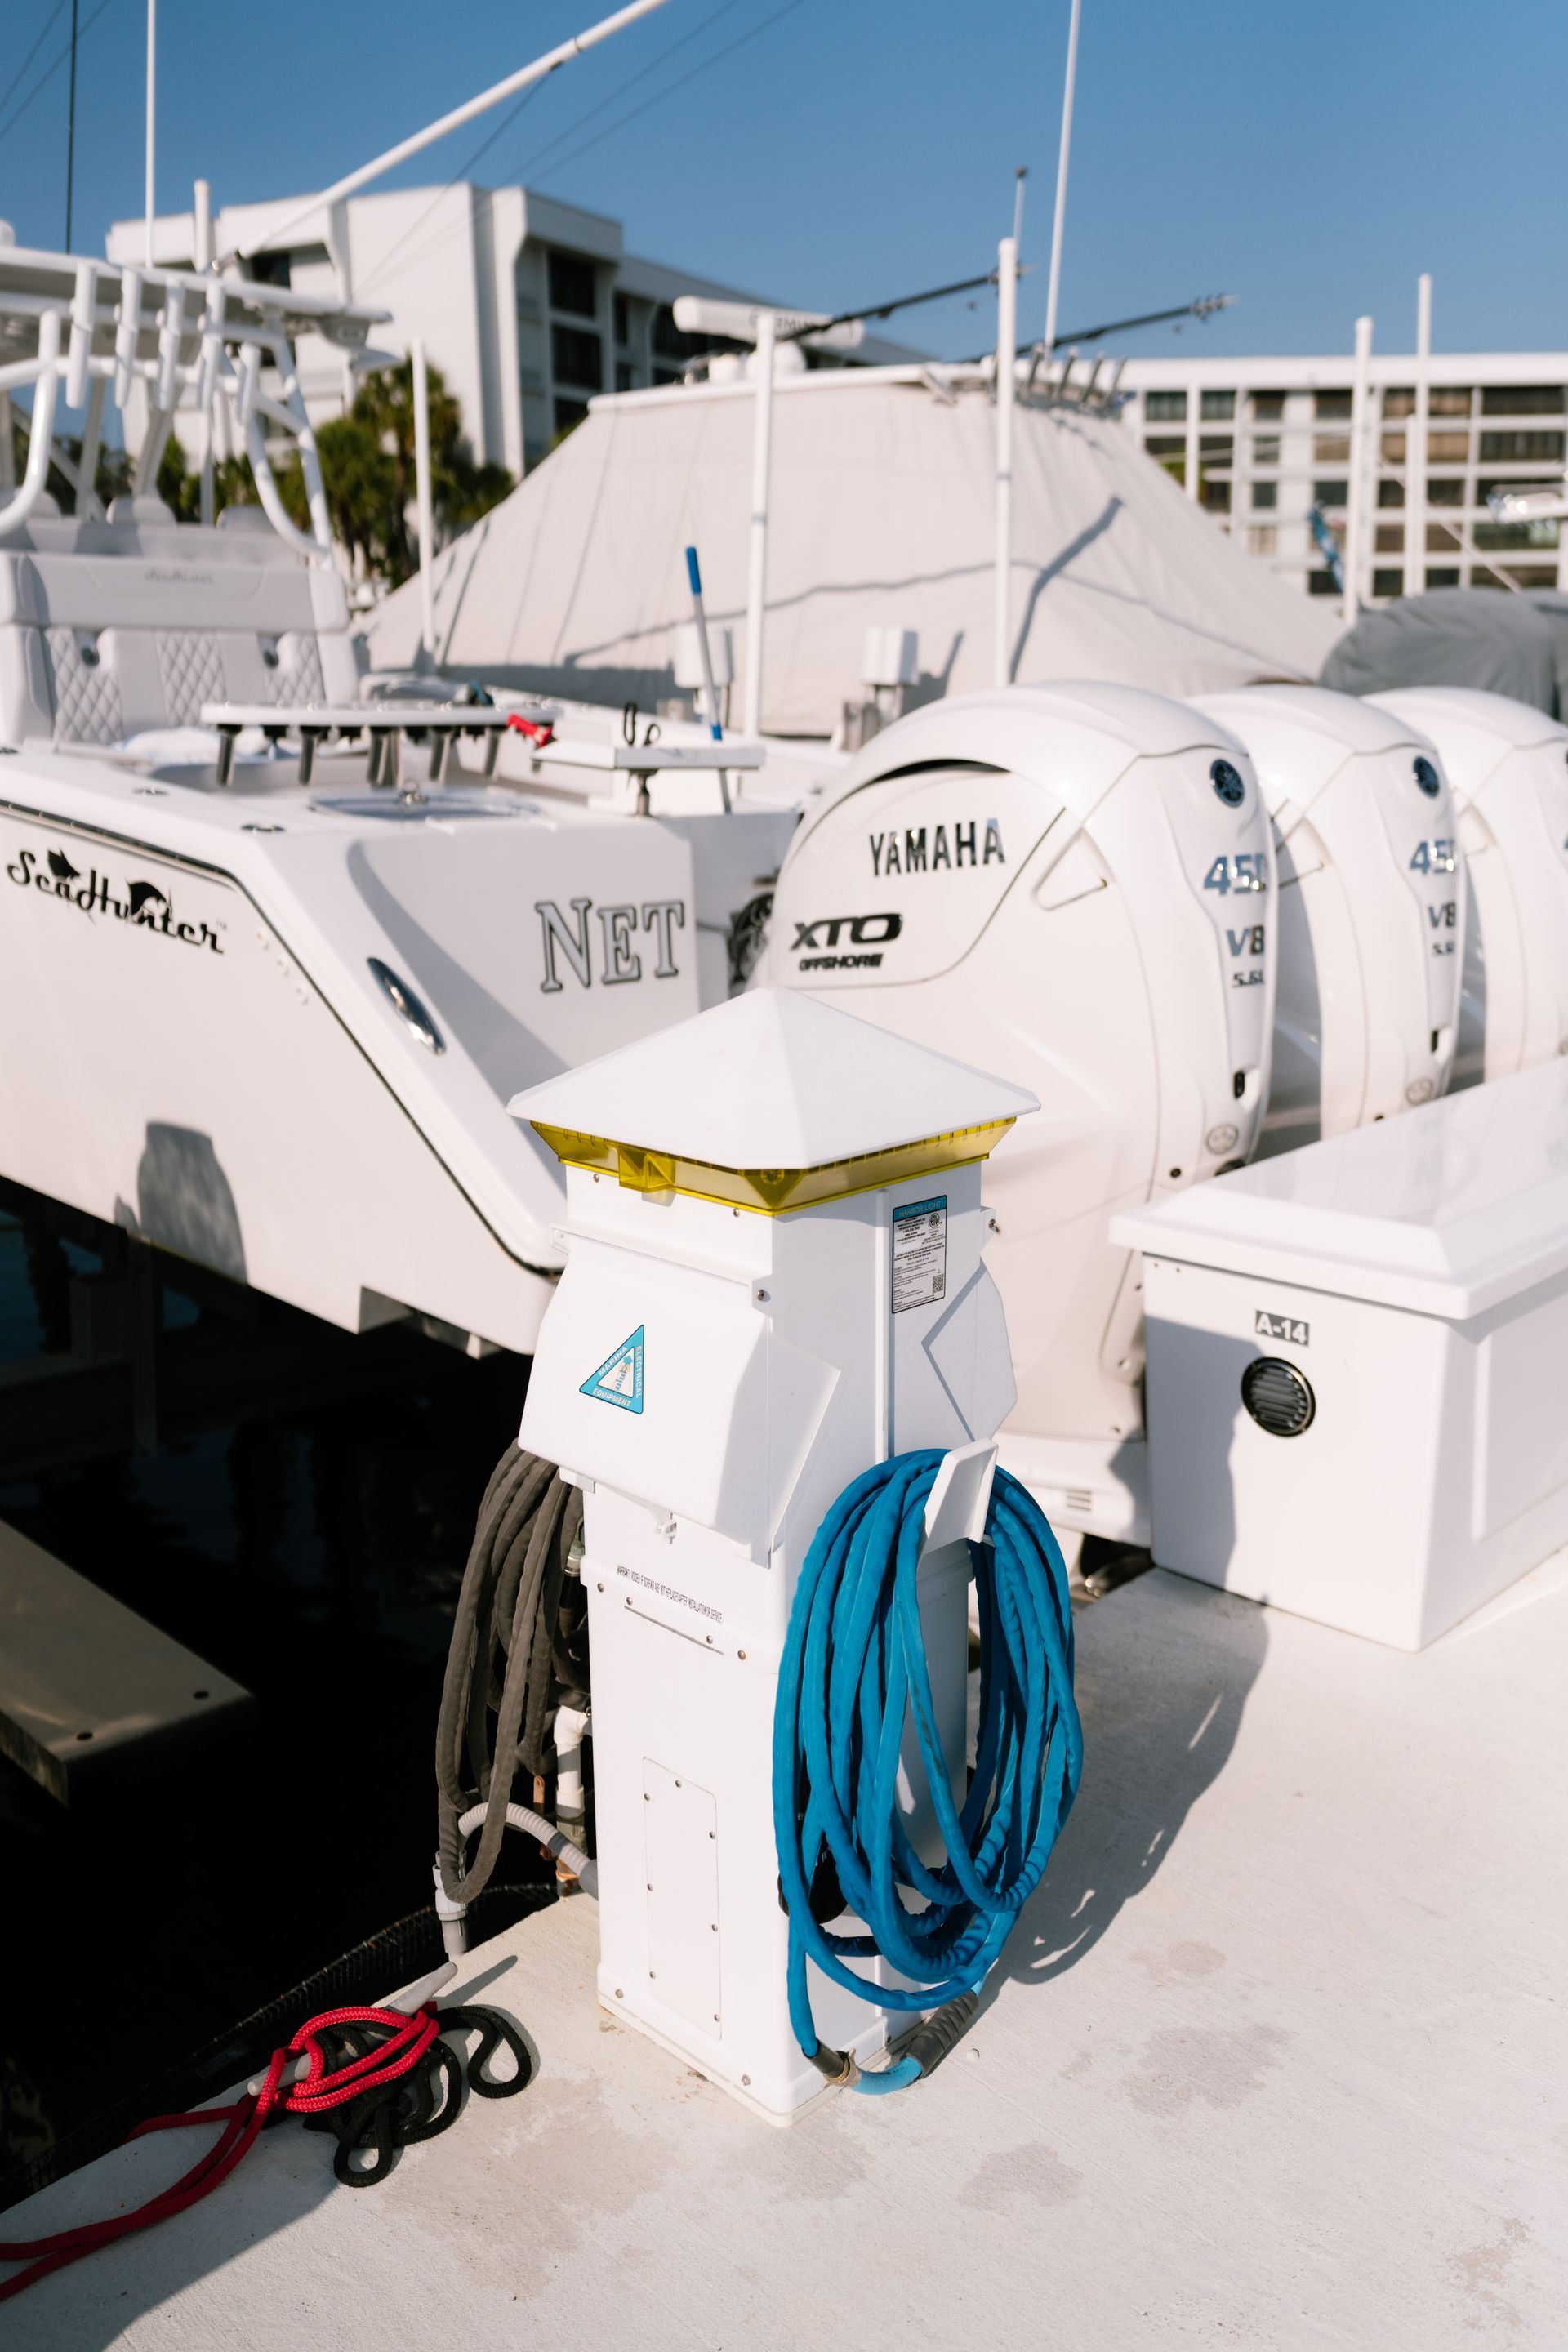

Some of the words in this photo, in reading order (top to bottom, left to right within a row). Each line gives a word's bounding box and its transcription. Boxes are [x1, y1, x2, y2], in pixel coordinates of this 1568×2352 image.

[870, 818, 1005, 876] YAMAHA
[534, 897, 685, 993] NET
[790, 913, 902, 951] XTO
[1226, 924, 1265, 957] V8
[799, 952, 884, 971] OFFSHORE
[898, 1205, 924, 1217] HARBOR
[924, 1200, 942, 1211] LIGHT
[1256, 1312, 1307, 1344] A-14
[598, 1346, 627, 1376] MARINA
[592, 1388, 632, 1407] EQUIPMENT
